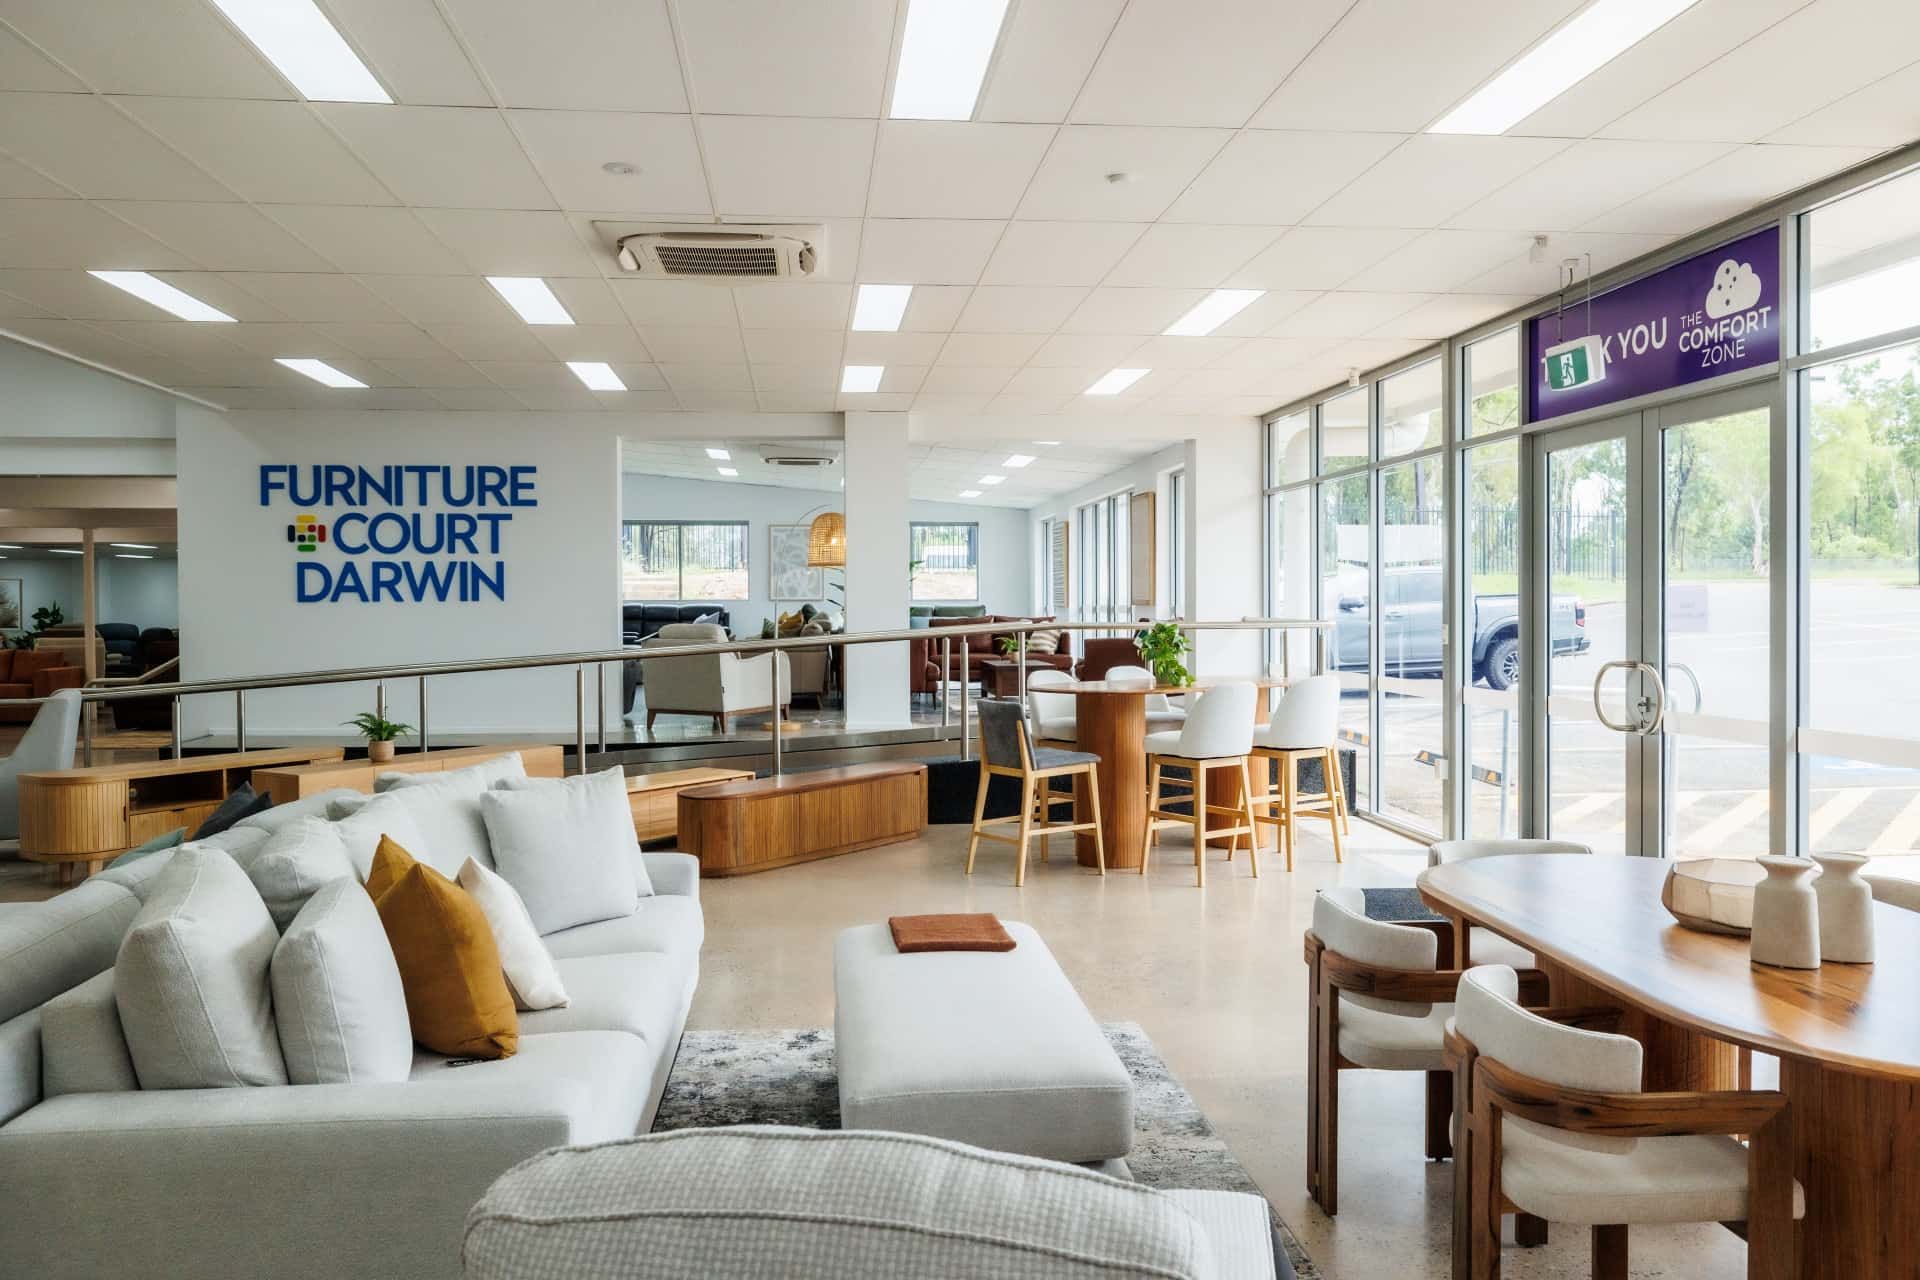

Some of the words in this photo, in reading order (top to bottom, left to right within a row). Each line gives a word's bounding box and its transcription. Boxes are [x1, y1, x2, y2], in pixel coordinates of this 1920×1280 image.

[1617, 316, 1667, 359] YOU
[1679, 306, 1771, 352] COMFORT
[1680, 310, 1702, 328] THE
[1701, 338, 1745, 367] ZONE
[260, 465, 538, 507] FURNITURE
[333, 512, 512, 554] COURT
[297, 561, 504, 603] DARWIN
